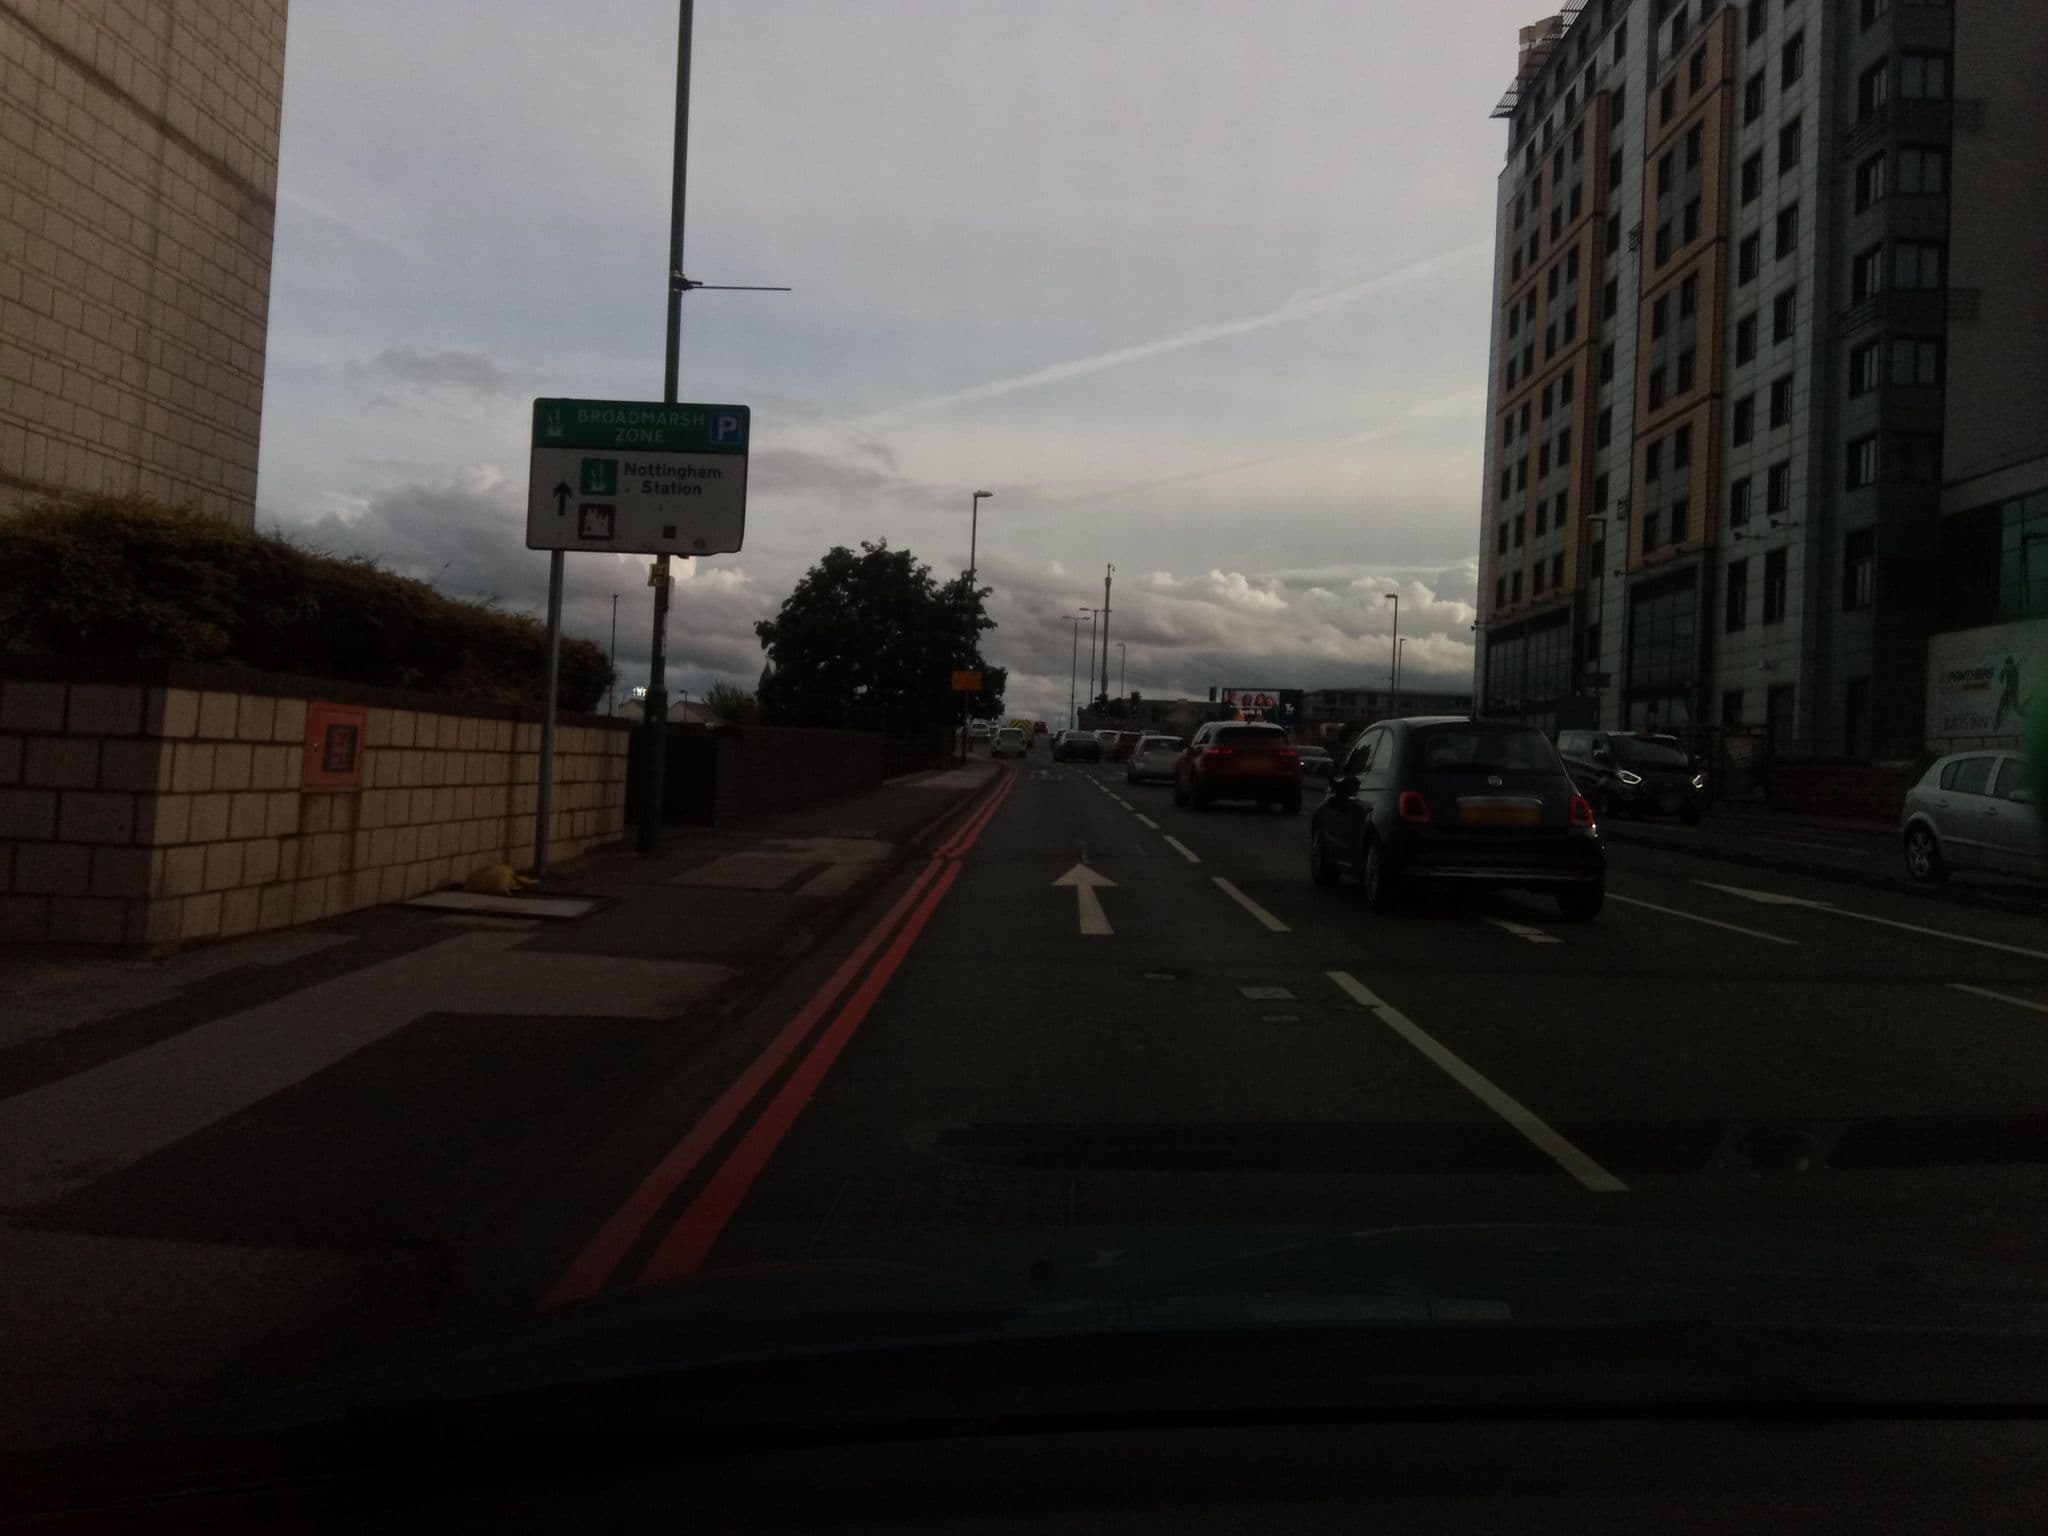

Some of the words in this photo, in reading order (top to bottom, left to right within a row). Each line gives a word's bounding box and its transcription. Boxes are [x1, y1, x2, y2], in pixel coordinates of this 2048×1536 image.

[577, 408, 706, 428] BROADMARSH
[615, 427, 665, 443] ZONE
[717, 416, 738, 441] P
[624, 463, 721, 480] Nottingham
[641, 480, 702, 496] Station
